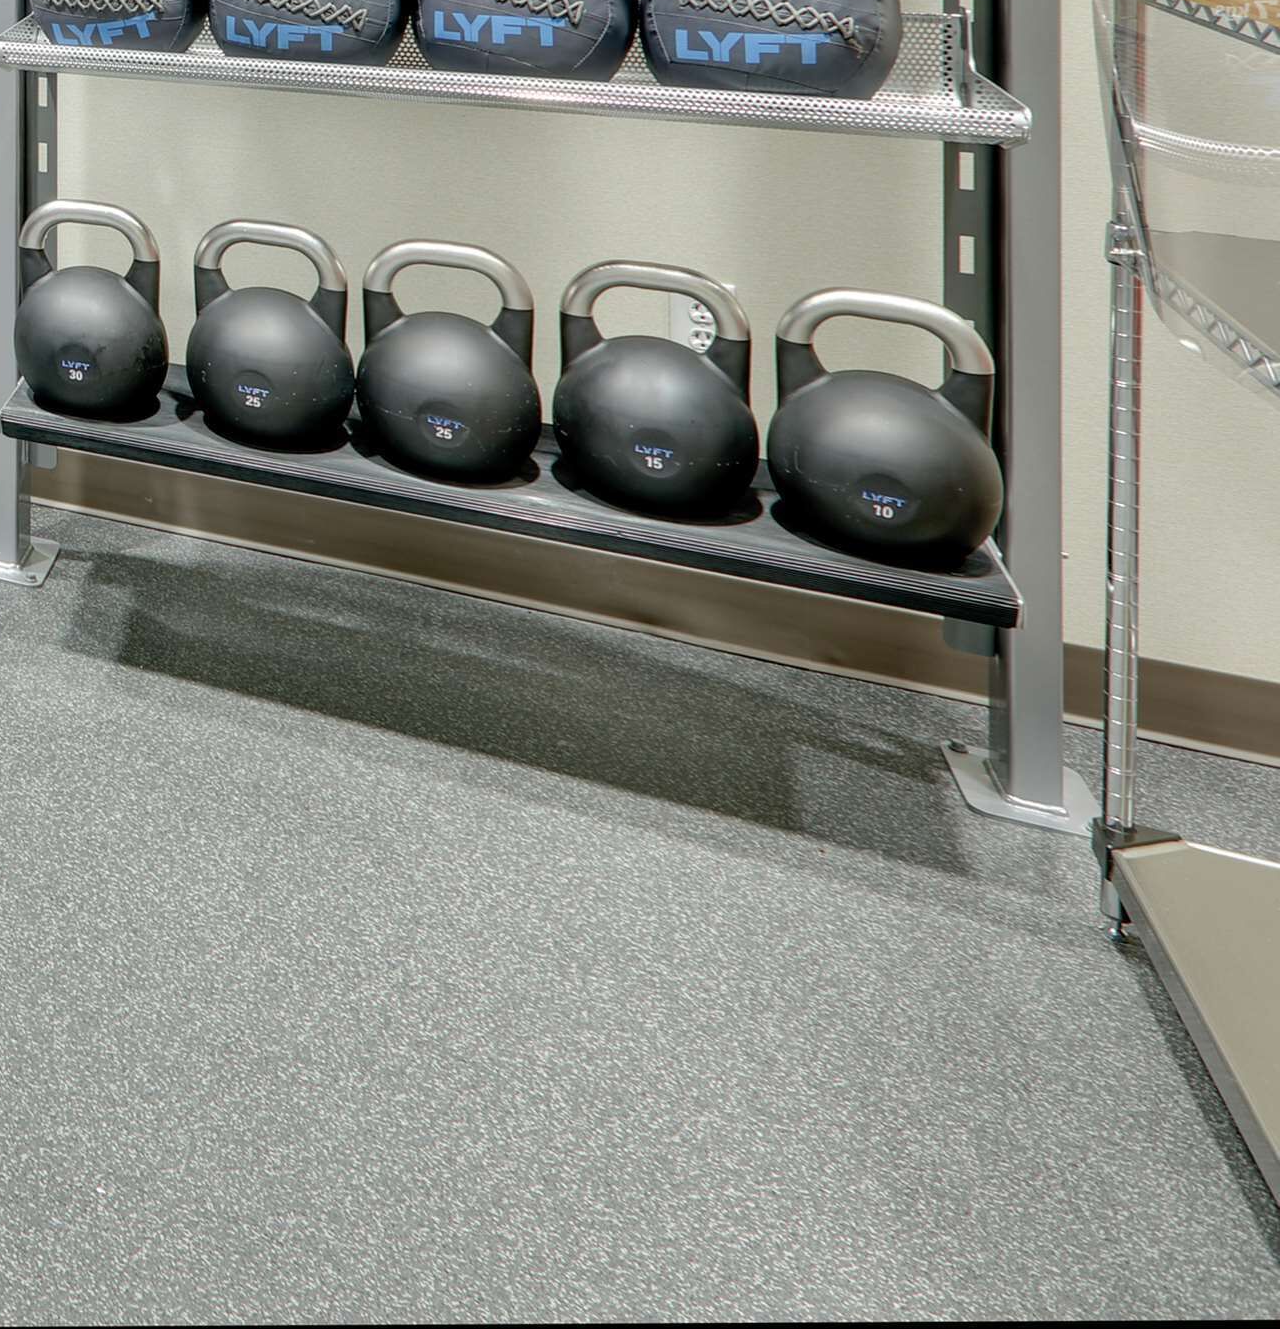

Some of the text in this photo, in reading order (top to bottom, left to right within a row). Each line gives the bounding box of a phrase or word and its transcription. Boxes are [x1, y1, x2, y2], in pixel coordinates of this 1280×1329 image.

[50, 11, 157, 47] LYFT
[225, 15, 346, 52] LYFT
[433, 10, 568, 47] LYFT
[674, 28, 832, 65] LYFT
[62, 360, 91, 371] LYFT
[69, 370, 83, 381] 30
[238, 384, 270, 398] LYFT
[245, 396, 262, 408] 25
[426, 417, 465, 430] LYFT
[435, 426, 453, 440] 25
[634, 443, 674, 459] LYFT
[645, 456, 664, 471] 15
[861, 490, 905, 507] LYFT
[873, 504, 894, 520] 10
